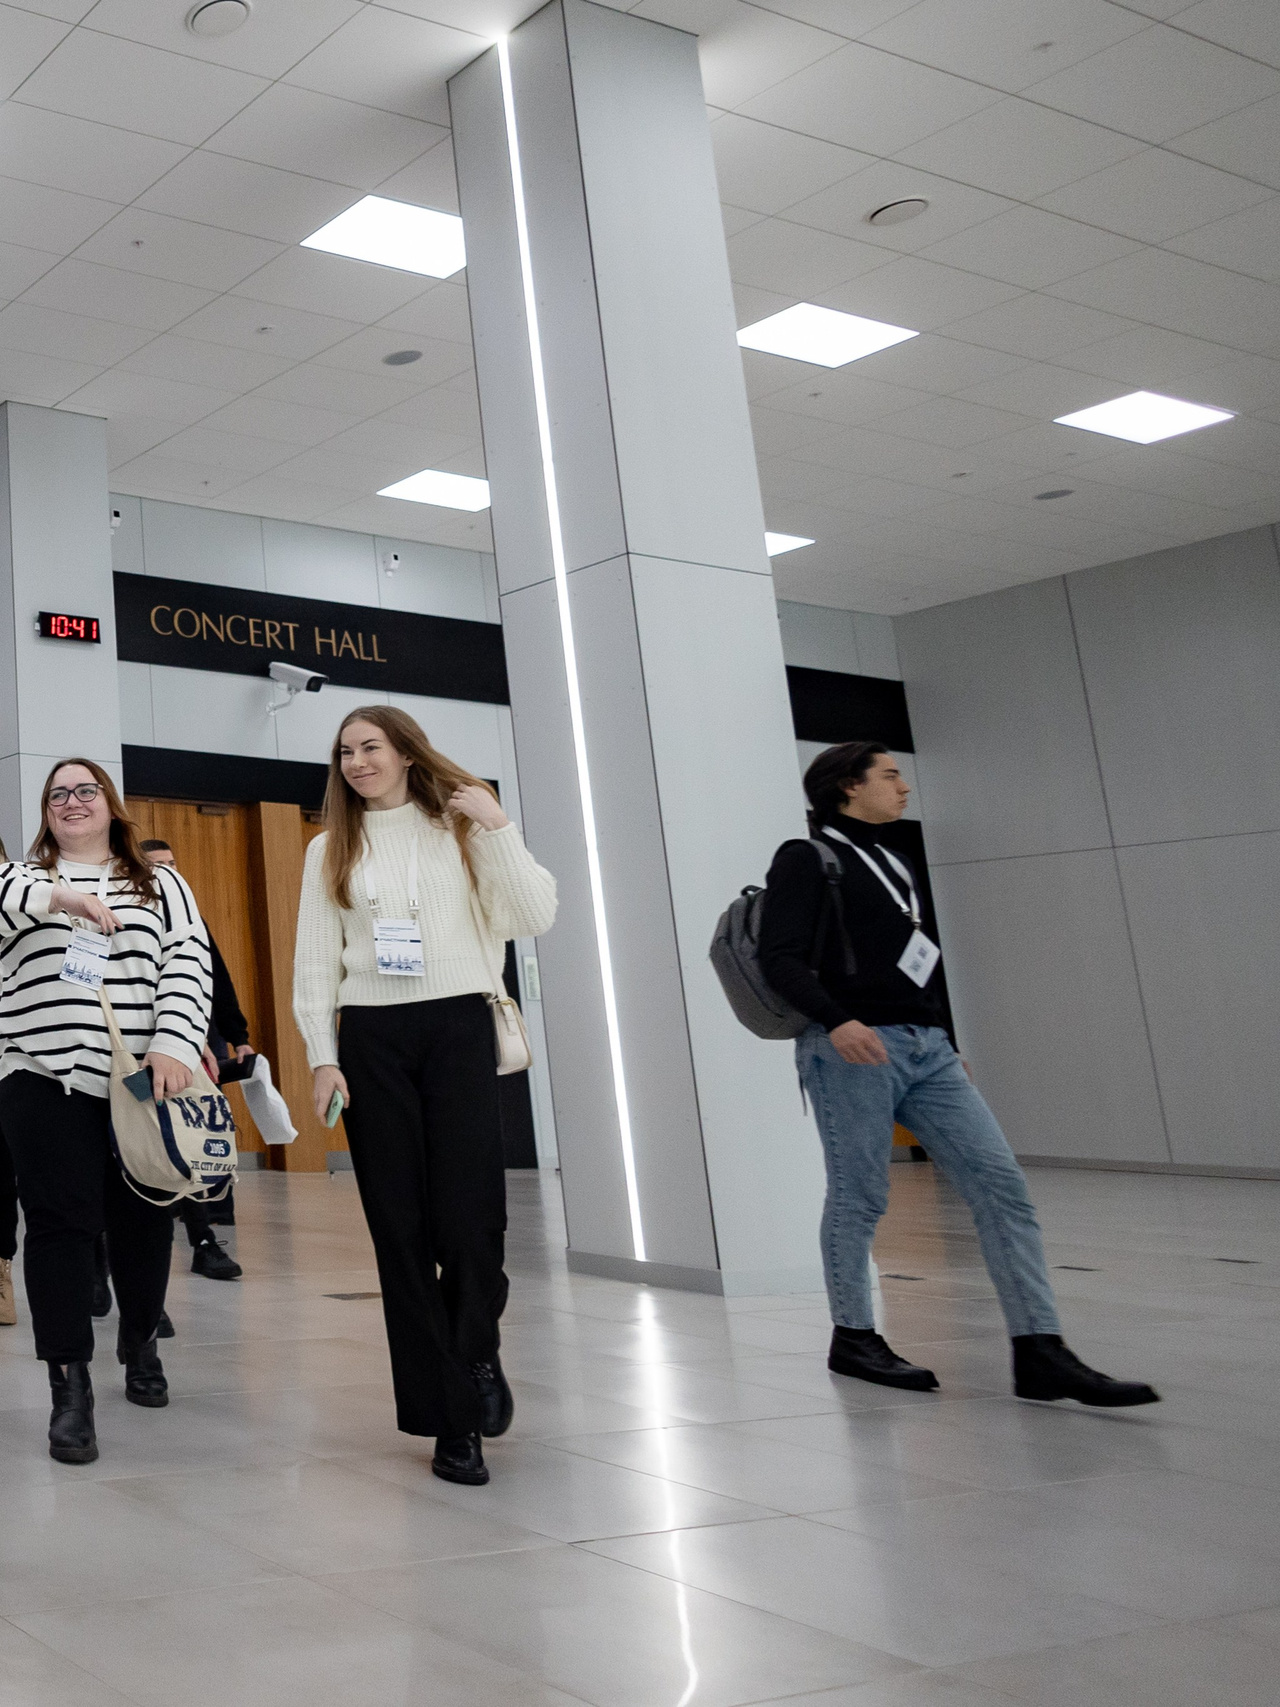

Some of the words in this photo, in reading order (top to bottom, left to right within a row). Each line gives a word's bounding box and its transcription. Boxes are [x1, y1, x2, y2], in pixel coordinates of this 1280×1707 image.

[51, 616, 97, 639] 10:41
[150, 605, 299, 652] CONCERT
[315, 627, 388, 663] HALL
